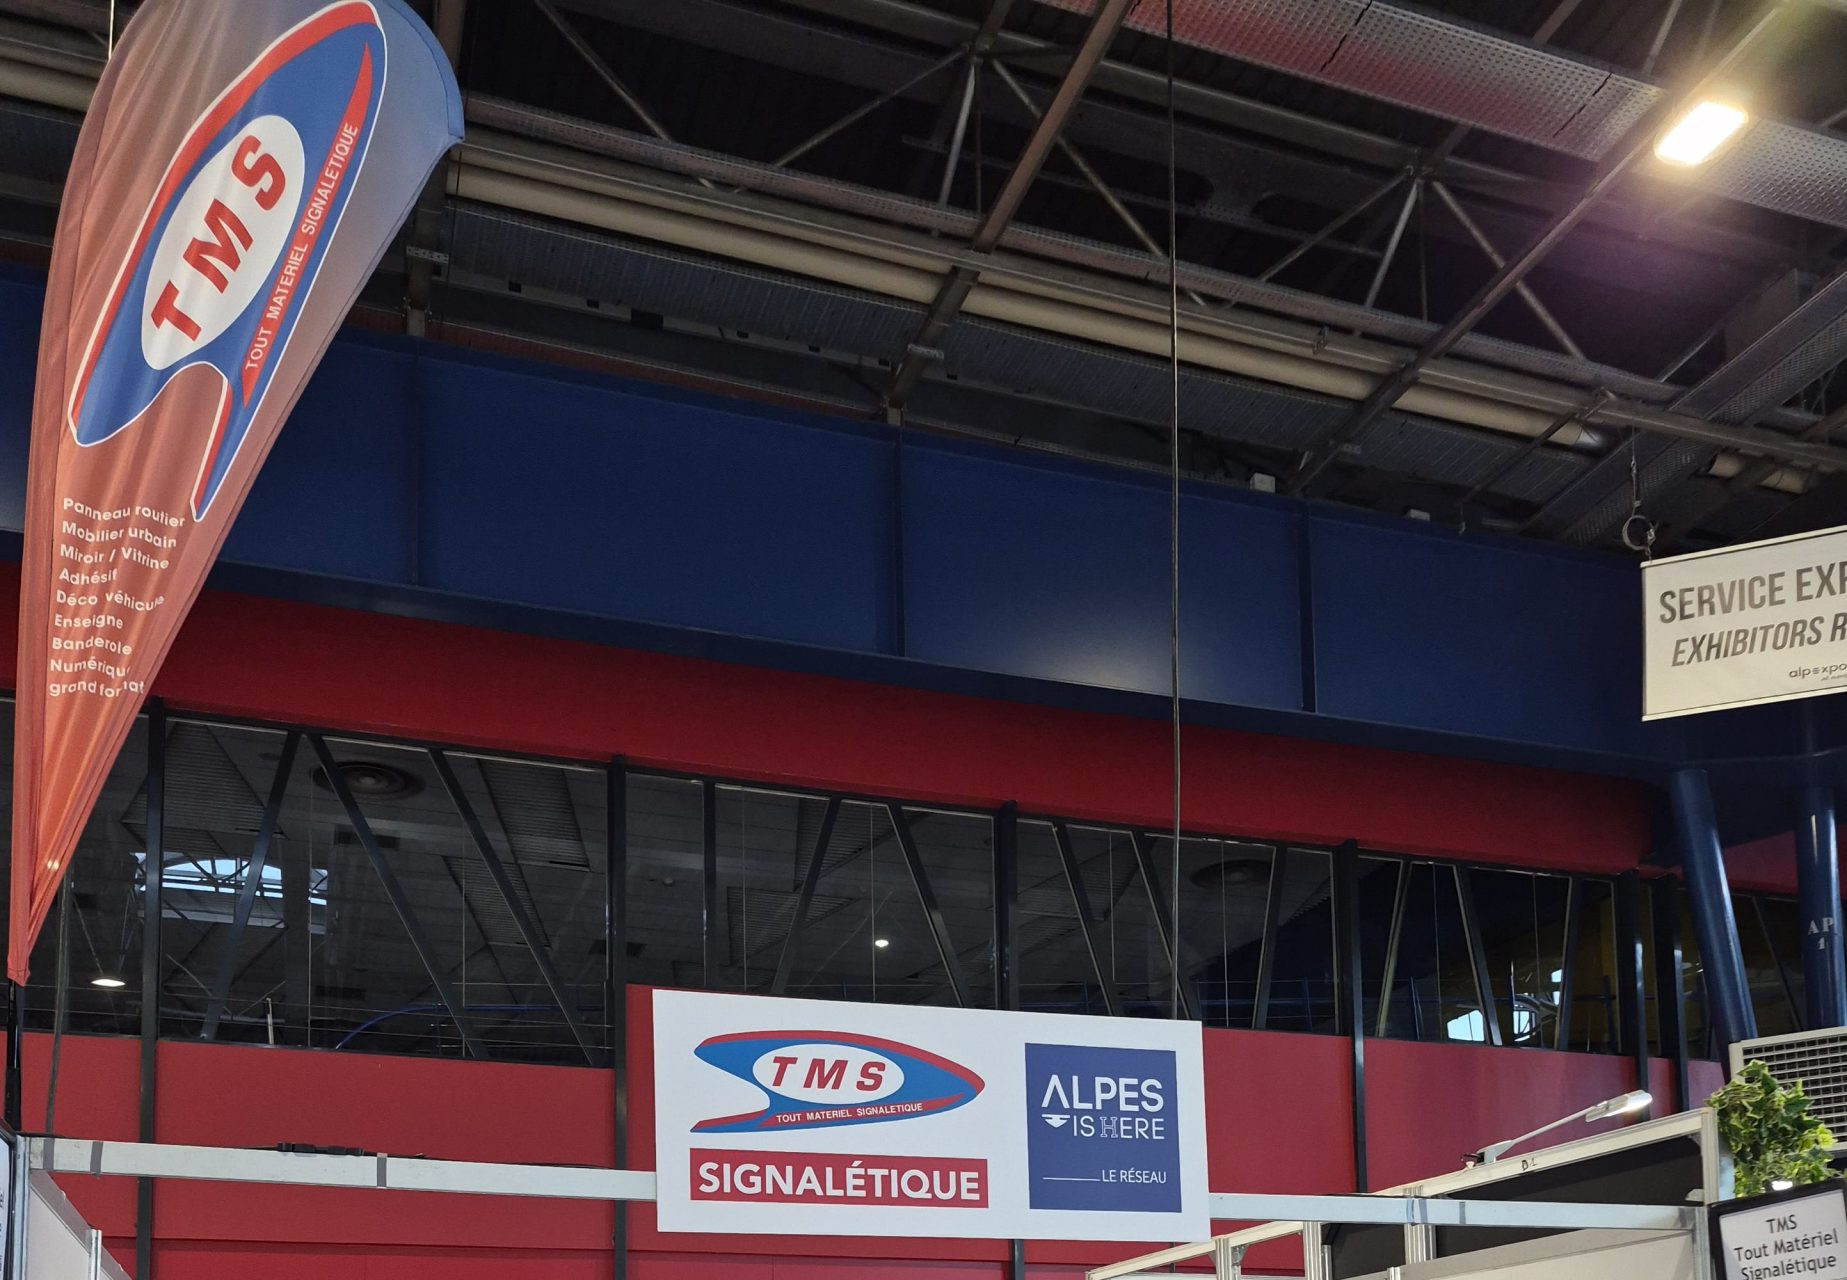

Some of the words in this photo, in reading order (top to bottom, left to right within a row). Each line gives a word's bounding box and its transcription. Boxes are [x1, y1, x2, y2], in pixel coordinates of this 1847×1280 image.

[151, 135, 286, 342] TMS
[245, 327, 270, 370] TOUT
[266, 243, 309, 321] MATERIEL
[301, 123, 359, 235] SIGNALETIQUE
[63, 498, 130, 520] Panneau
[135, 506, 185, 527] routier
[62, 521, 124, 542] Mobilier
[129, 528, 177, 548] urbain
[60, 544, 104, 563] Miroir
[121, 547, 169, 569] Vitrine
[59, 568, 118, 584] Adhésif
[57, 590, 98, 606] Déco
[1659, 572, 1786, 624] SERVICE
[55, 614, 123, 629] Enseigne
[52, 637, 132, 655] Banderole
[1671, 616, 1824, 667] EXHIBITORS
[49, 681, 97, 696] grand
[770, 1056, 886, 1091] TMS
[1041, 1074, 1165, 1113] ALPES
[776, 1112, 802, 1124] TOUT
[806, 1109, 853, 1121] MATERIEL
[856, 1102, 924, 1117] SIGNALETIQUE
[1074, 1117, 1094, 1137] IS
[1100, 1117, 1165, 1139] HERE
[699, 1161, 980, 1201] SIGNALÉTIQUE
[1102, 1170, 1117, 1183] LE
[1120, 1167, 1167, 1183] RÉSEAU
[1766, 1214, 1798, 1234] TMS
[1734, 1244, 1769, 1261] Tout
[1774, 1228, 1839, 1255] Matériel
